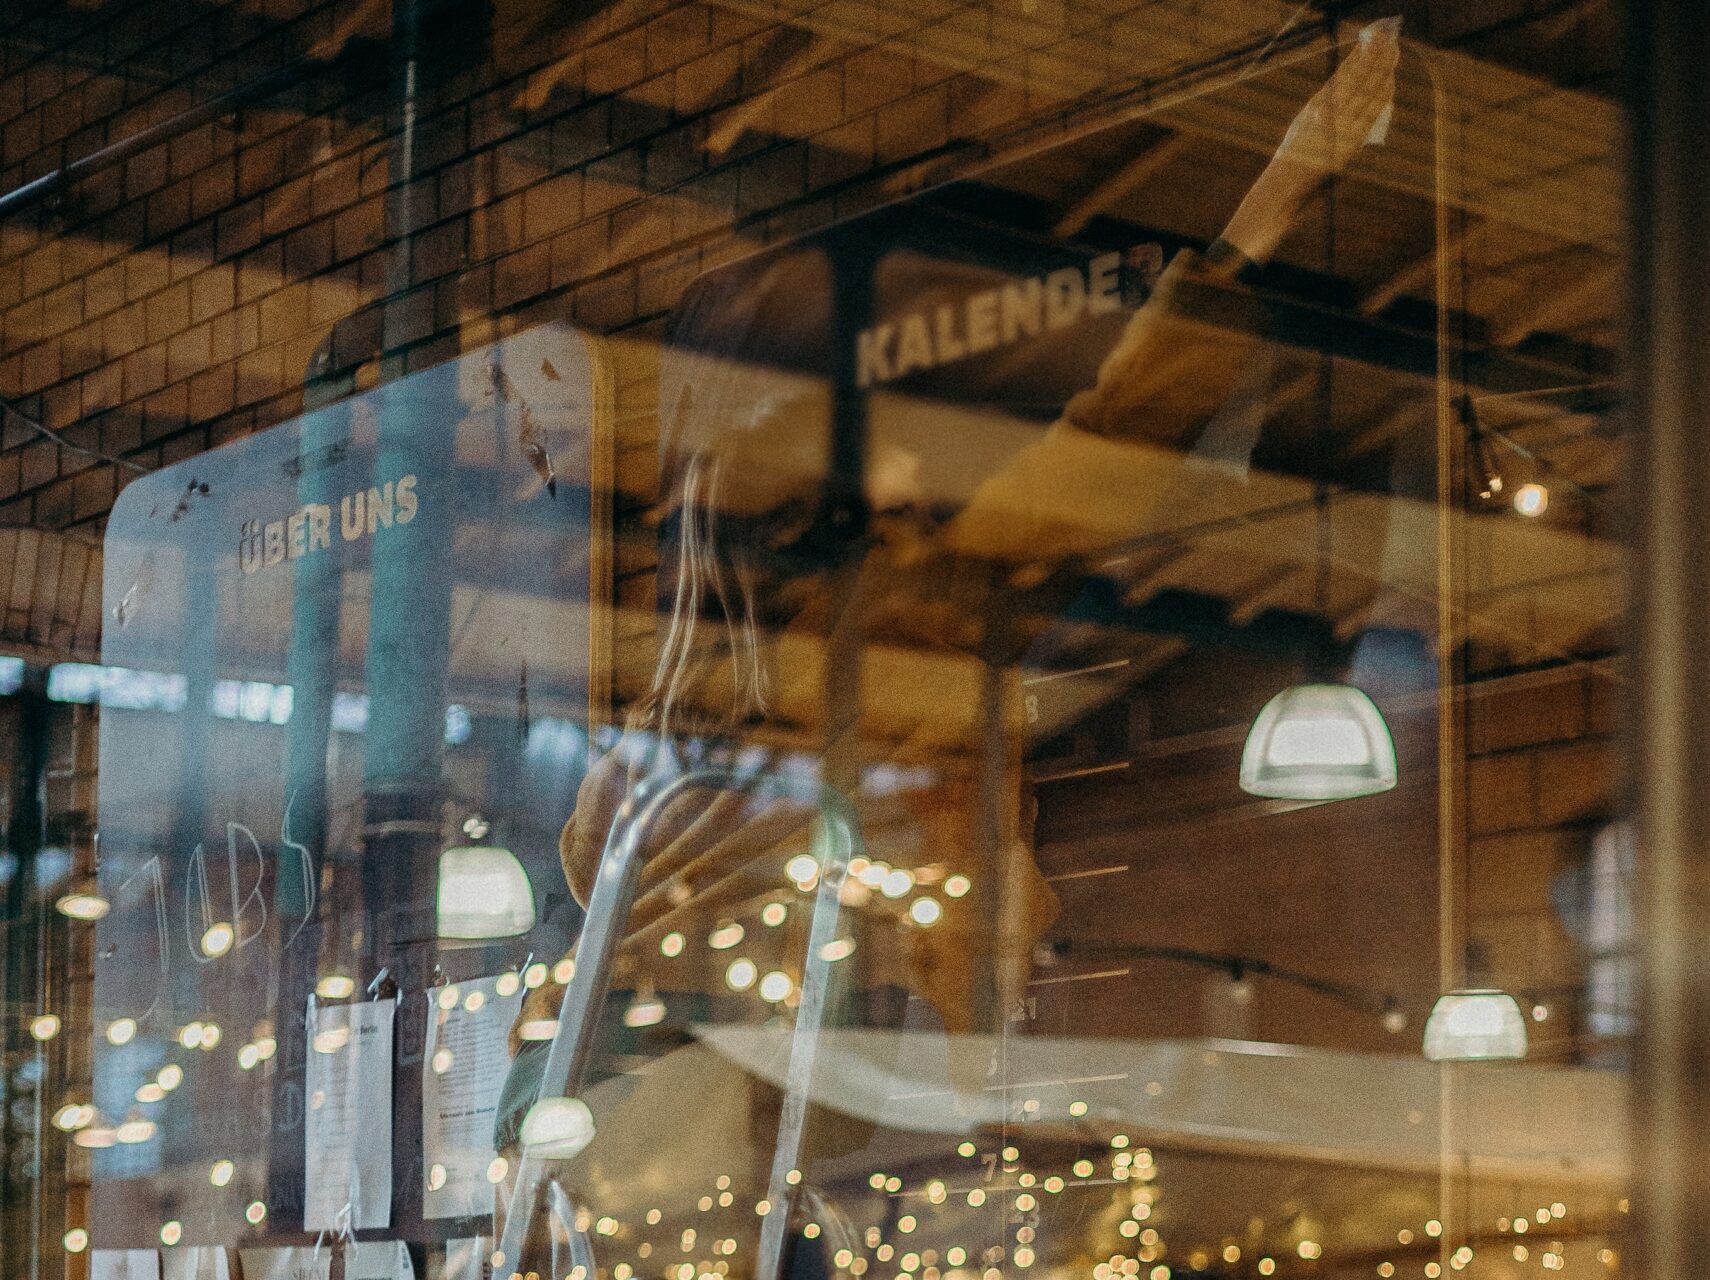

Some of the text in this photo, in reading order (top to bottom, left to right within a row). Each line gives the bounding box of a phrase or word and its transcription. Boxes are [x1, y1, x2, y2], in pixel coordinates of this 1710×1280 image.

[240, 474, 418, 575] ÜBER UNS
[981, 1152, 997, 1182] 7
